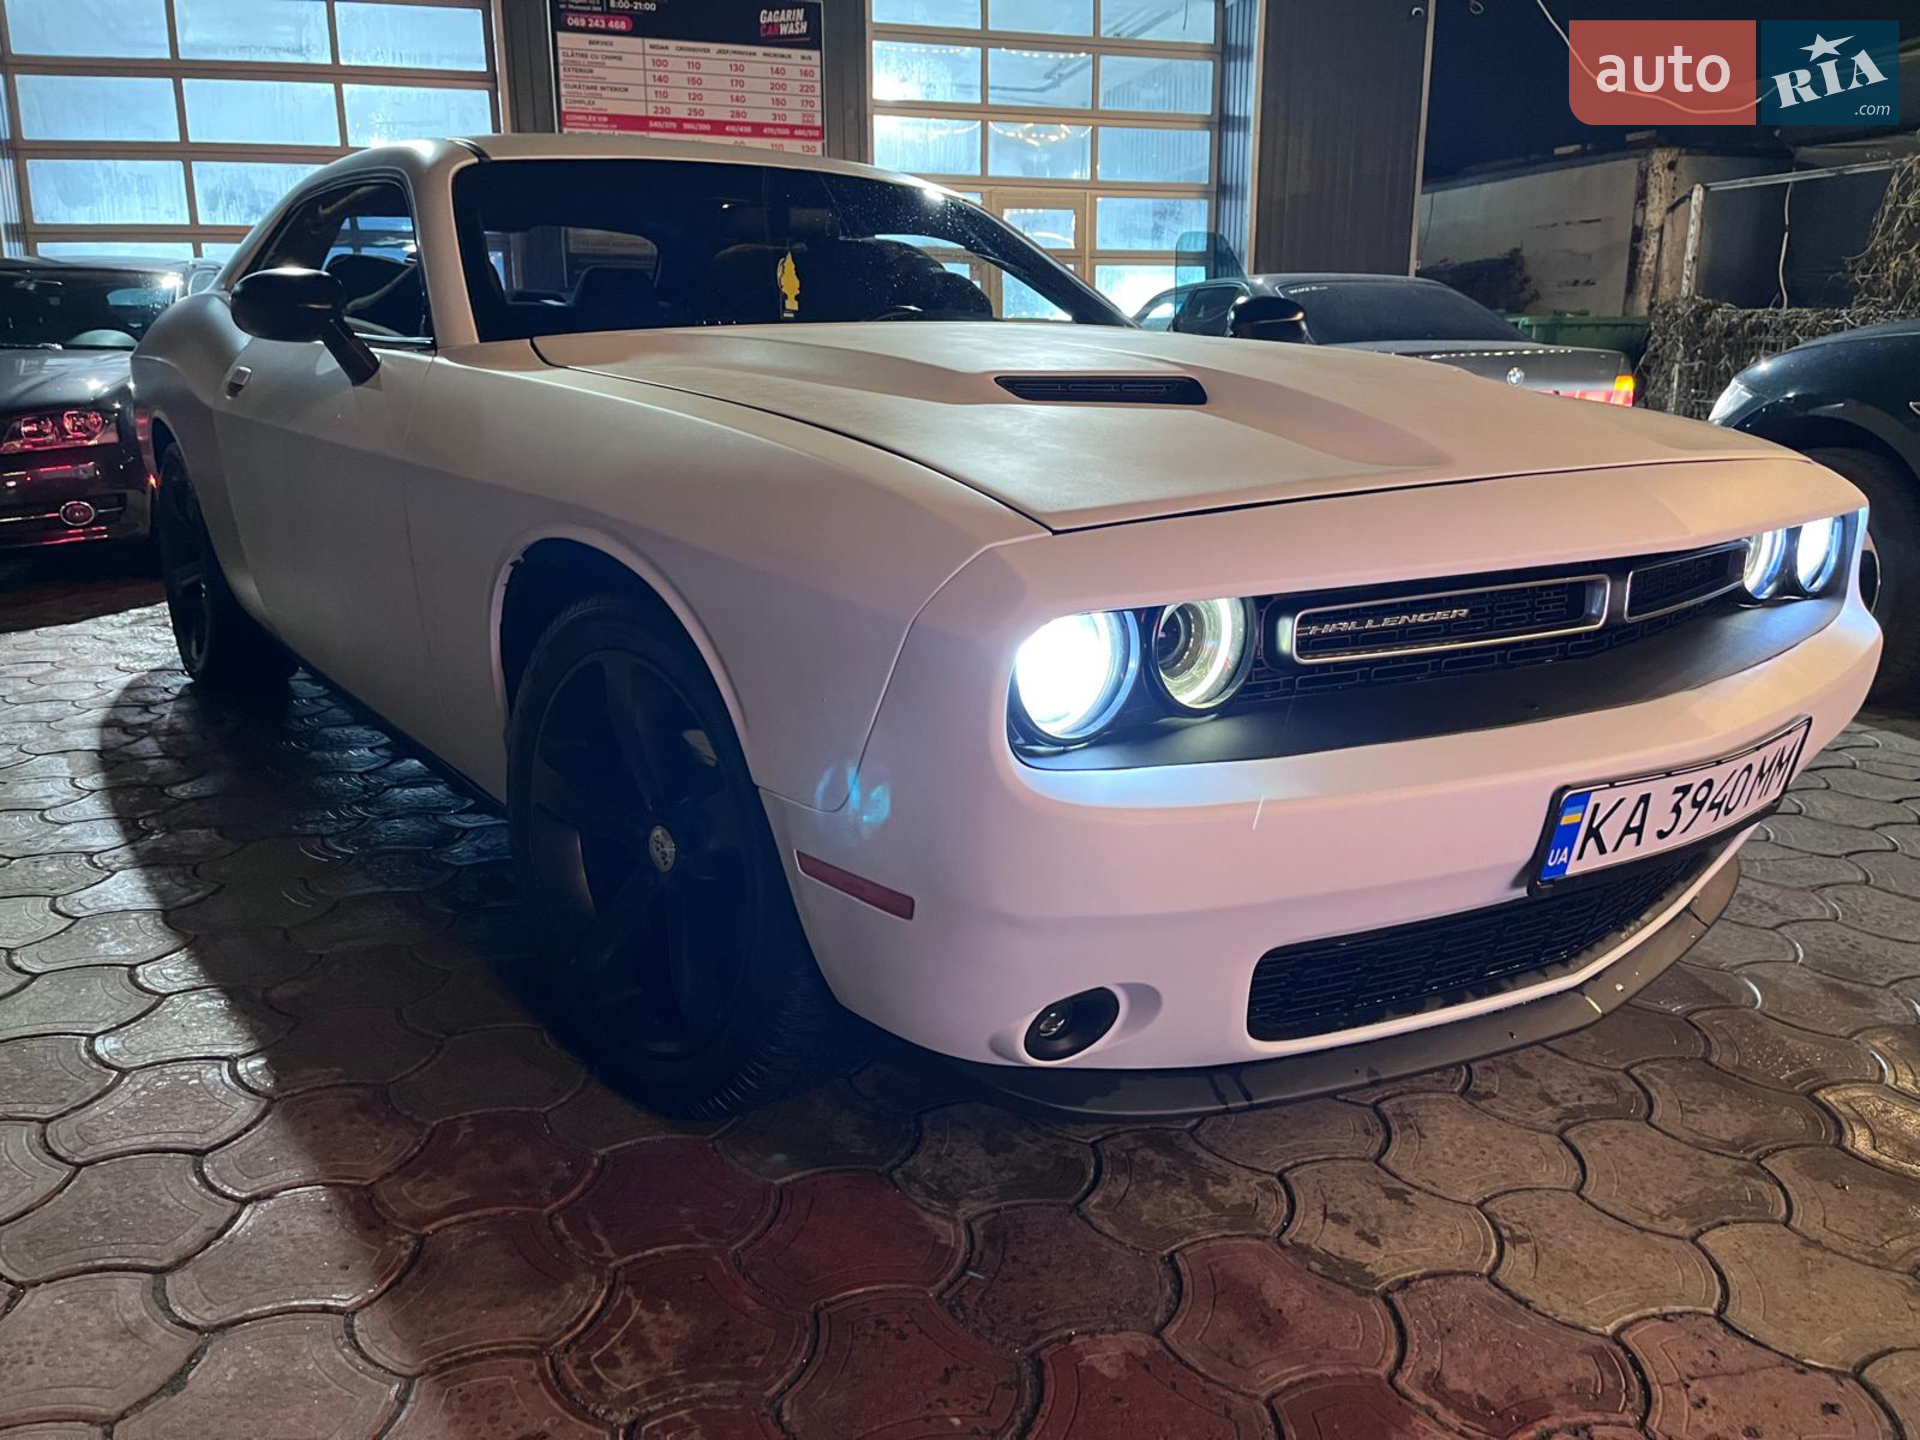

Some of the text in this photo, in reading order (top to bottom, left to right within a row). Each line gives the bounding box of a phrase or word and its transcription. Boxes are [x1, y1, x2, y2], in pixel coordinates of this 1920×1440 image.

[588, 19, 605, 28] 243
[759, 8, 805, 24] GAGARIN
[652, 58, 669, 68] 100
[687, 61, 702, 70] 110
[729, 63, 745, 72] 130
[770, 67, 786, 76] 140
[652, 75, 816, 93] 140 150 170 200 220
[654, 90, 815, 108] 110 120 140 150 170
[653, 106, 787, 122] 230 250 280 310
[801, 145, 817, 154] 130
[1296, 608, 1470, 636] CHALLENGER
[1576, 738, 1800, 861] KA 3940 MM
[1547, 846, 1569, 867] UA
